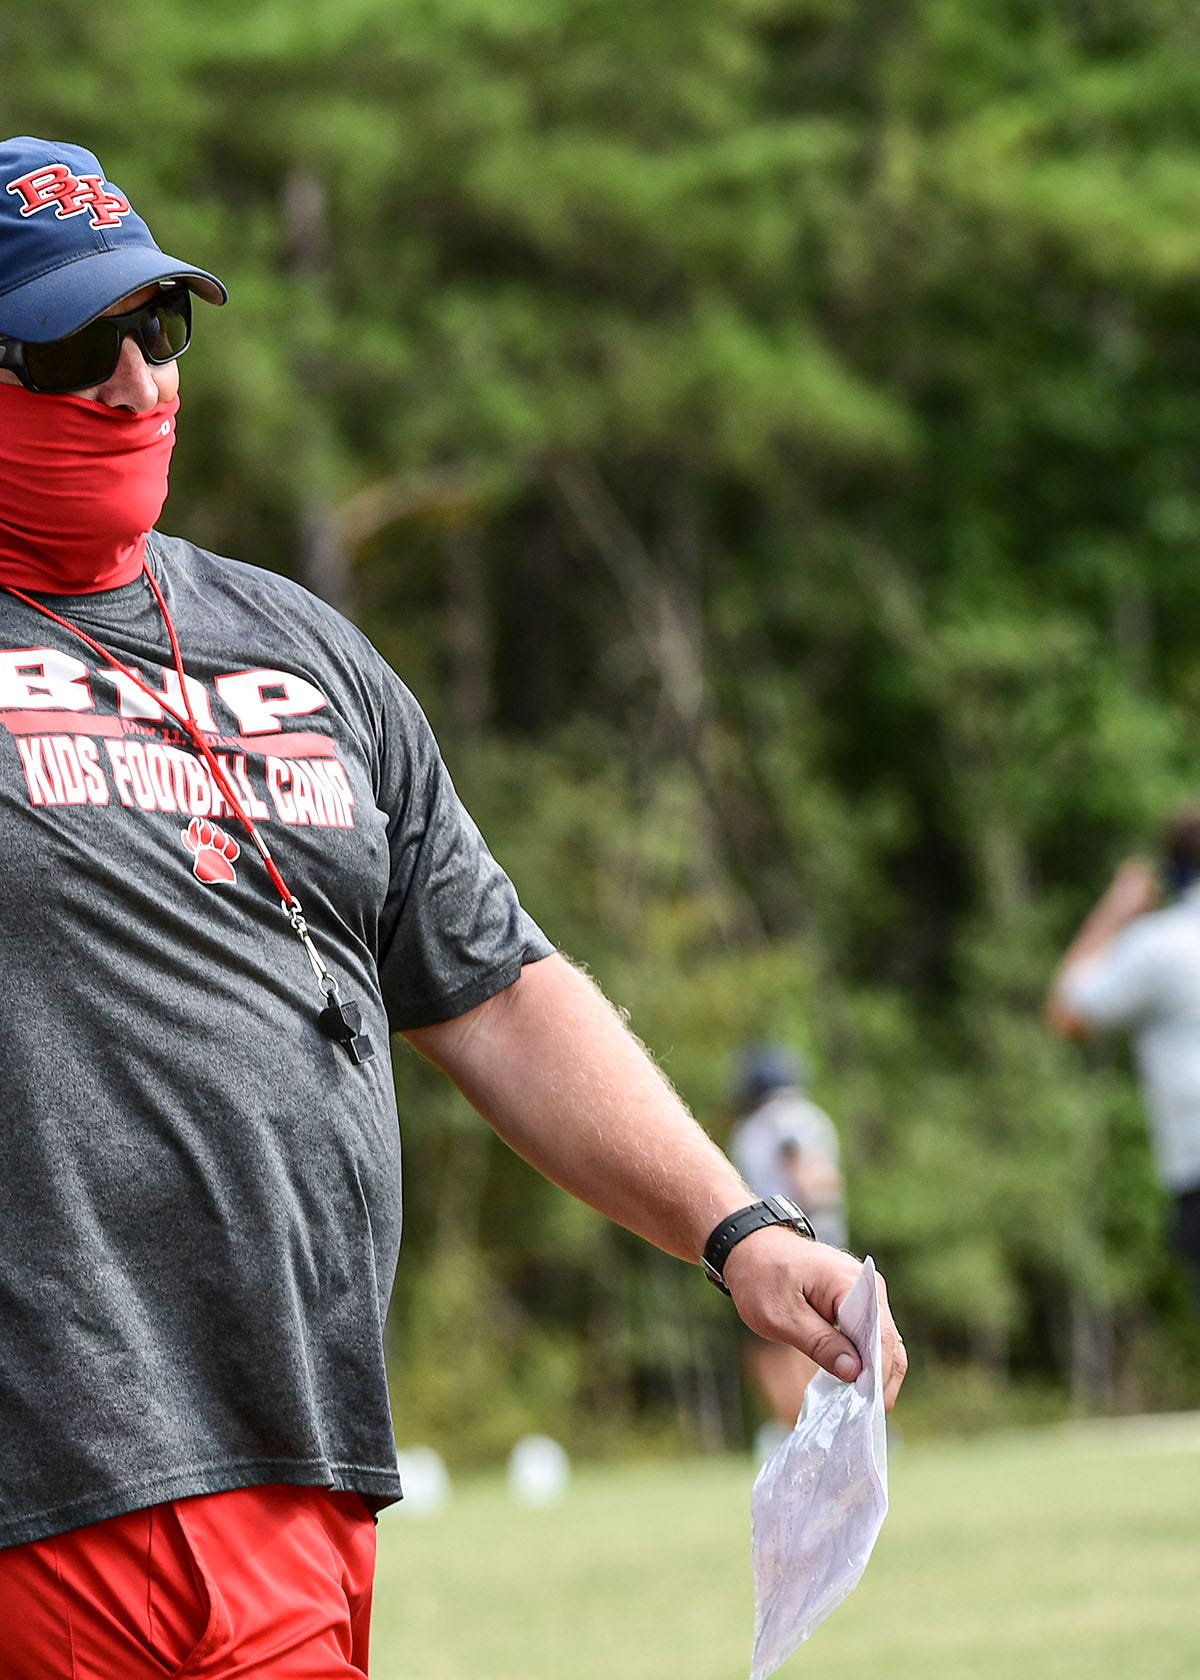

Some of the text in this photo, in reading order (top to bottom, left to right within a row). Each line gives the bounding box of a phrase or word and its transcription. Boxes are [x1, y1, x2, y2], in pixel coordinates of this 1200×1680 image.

[6, 163, 131, 230] BHP
[14, 734, 355, 829] KIDS FOOTBALL CAMP
